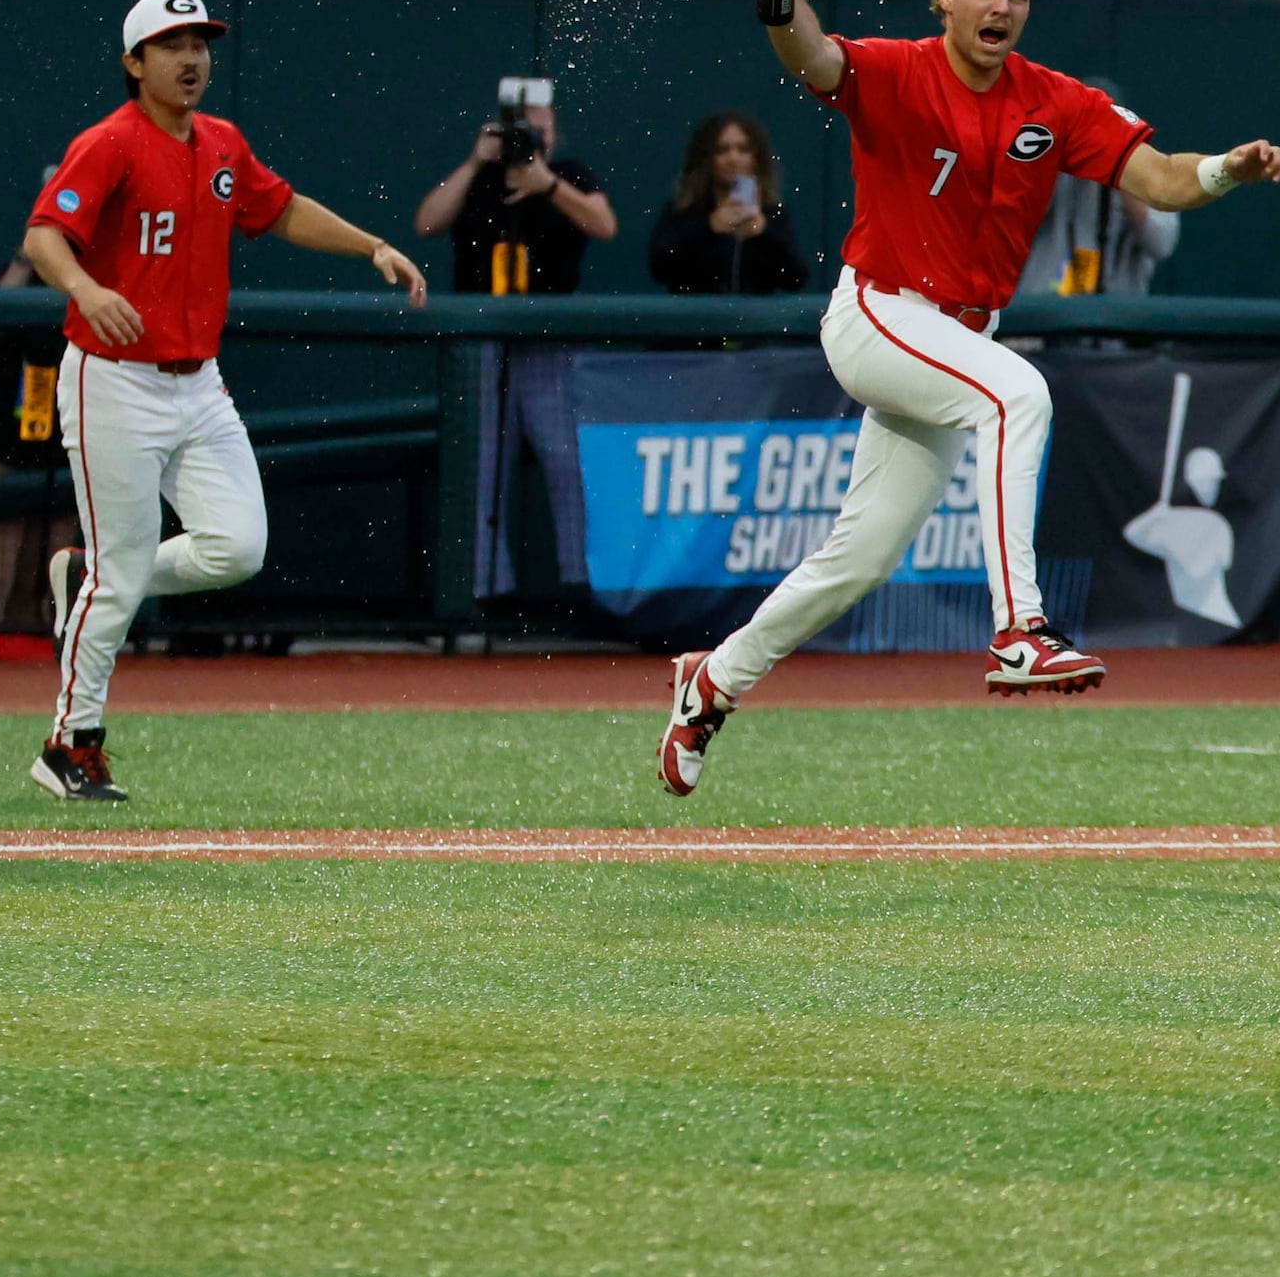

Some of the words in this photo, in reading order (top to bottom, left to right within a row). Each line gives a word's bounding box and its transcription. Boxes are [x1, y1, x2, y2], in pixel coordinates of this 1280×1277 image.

[1007, 124, 1054, 161] G
[212, 167, 235, 202] G
[929, 147, 958, 196] 7
[139, 211, 176, 255] 12
[637, 435, 747, 516] THE
[912, 515, 984, 570] DIR
